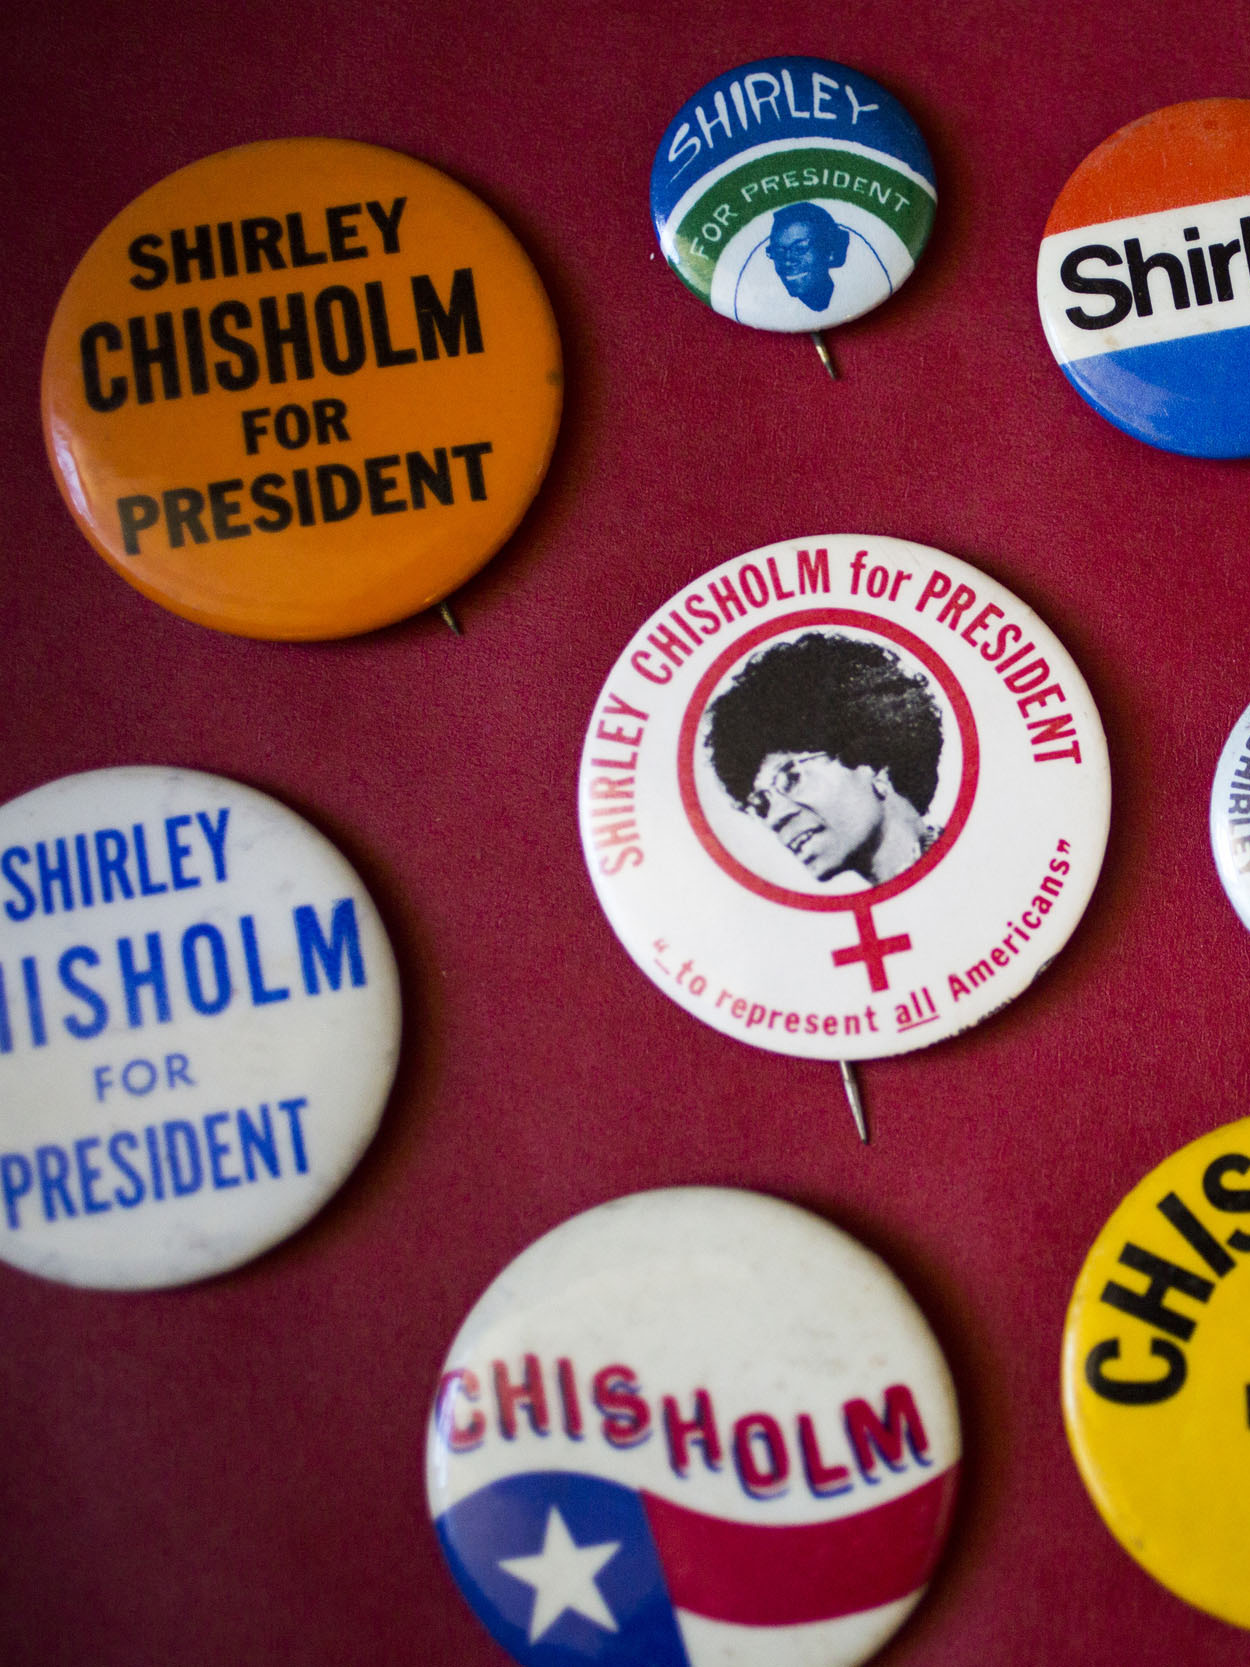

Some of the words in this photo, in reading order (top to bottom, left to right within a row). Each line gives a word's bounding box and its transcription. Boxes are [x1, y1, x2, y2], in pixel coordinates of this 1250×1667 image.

[666, 69, 879, 187] SHIRLEY
[127, 196, 408, 291] SHIRLEY
[690, 203, 738, 261] FOR
[740, 168, 911, 213] PRESIDENT
[79, 267, 485, 413] CHISHOLM
[241, 398, 351, 455] FOR
[116, 441, 493, 556] PRESIDENT
[590, 692, 650, 878] SHIRLEY
[630, 548, 831, 686] CHISHOLM
[849, 550, 913, 602] for
[915, 569, 1082, 766] PRESIDENT
[1, 807, 231, 923] SHIRLEY
[715, 988, 879, 1037] represent
[895, 987, 941, 1034] all
[93, 1053, 195, 1101] FOR
[0, 1098, 309, 1231] PRESIDENT
[435, 1352, 933, 1500] CHISHOLM
